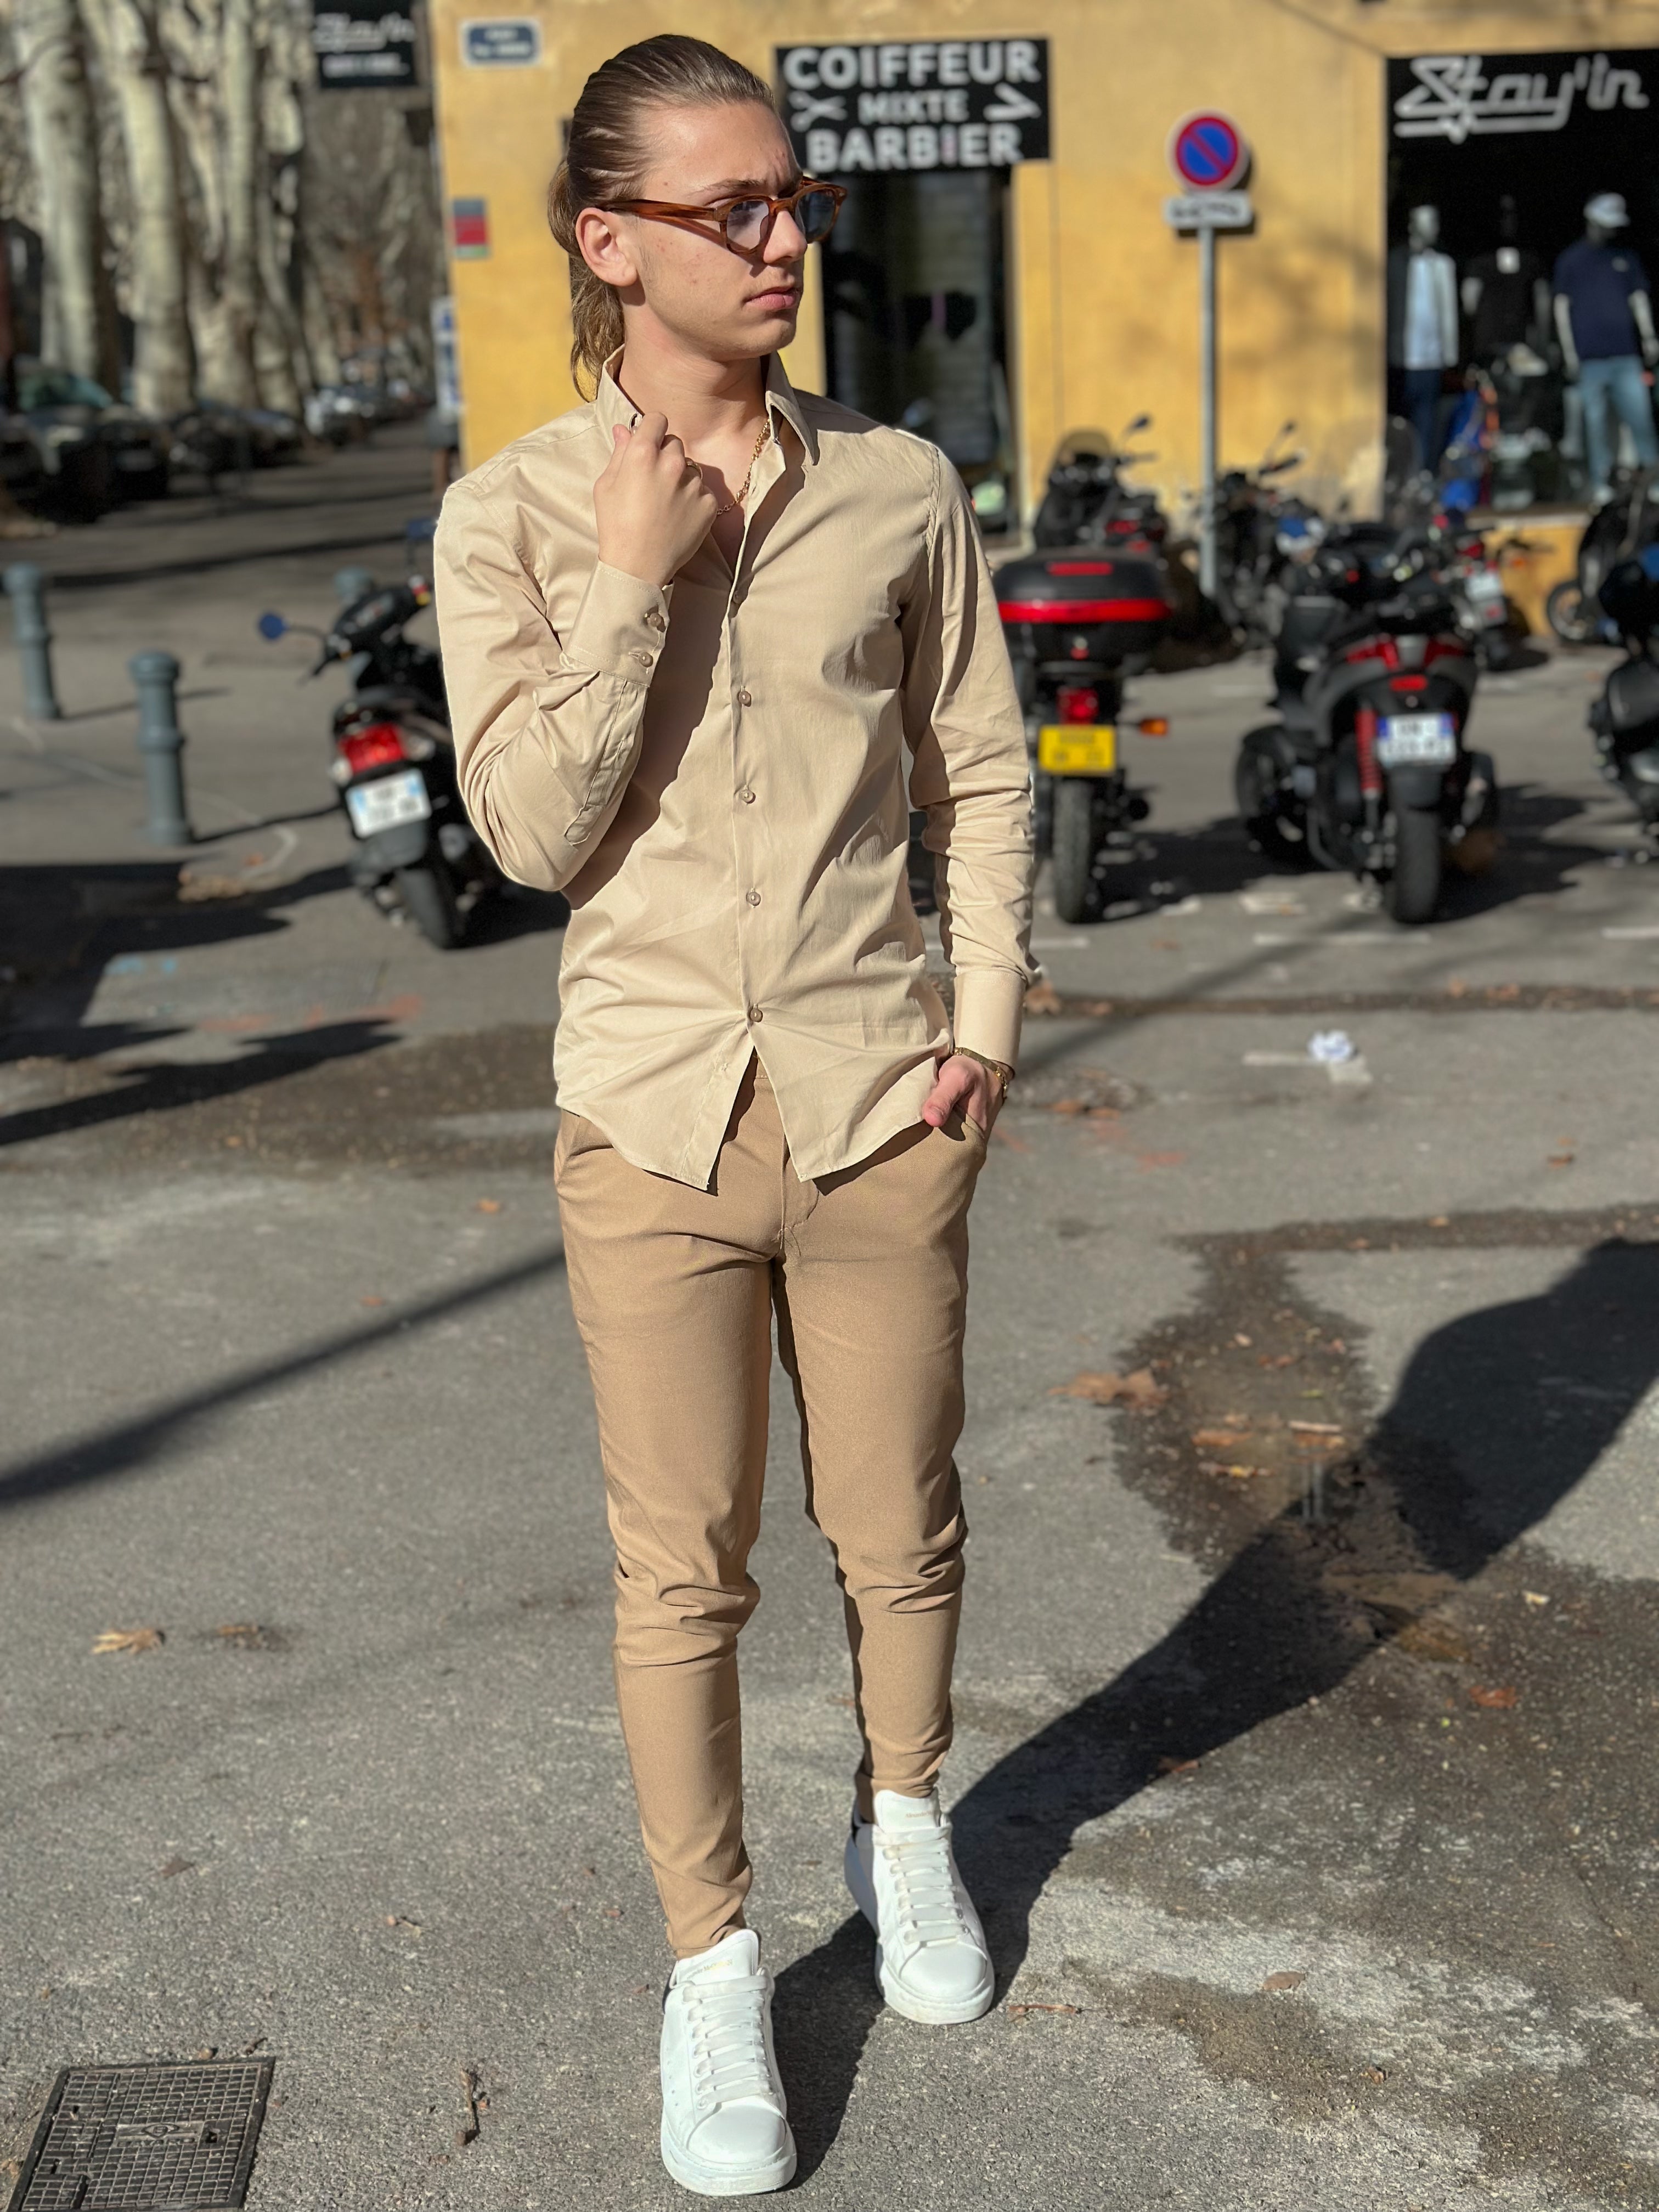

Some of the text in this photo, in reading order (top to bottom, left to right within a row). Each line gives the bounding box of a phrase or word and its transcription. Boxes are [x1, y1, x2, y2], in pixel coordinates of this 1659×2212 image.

[783, 41, 1040, 90] COIFFEUR
[857, 89, 969, 125] MIXTE
[806, 124, 1024, 173] BARBIER
